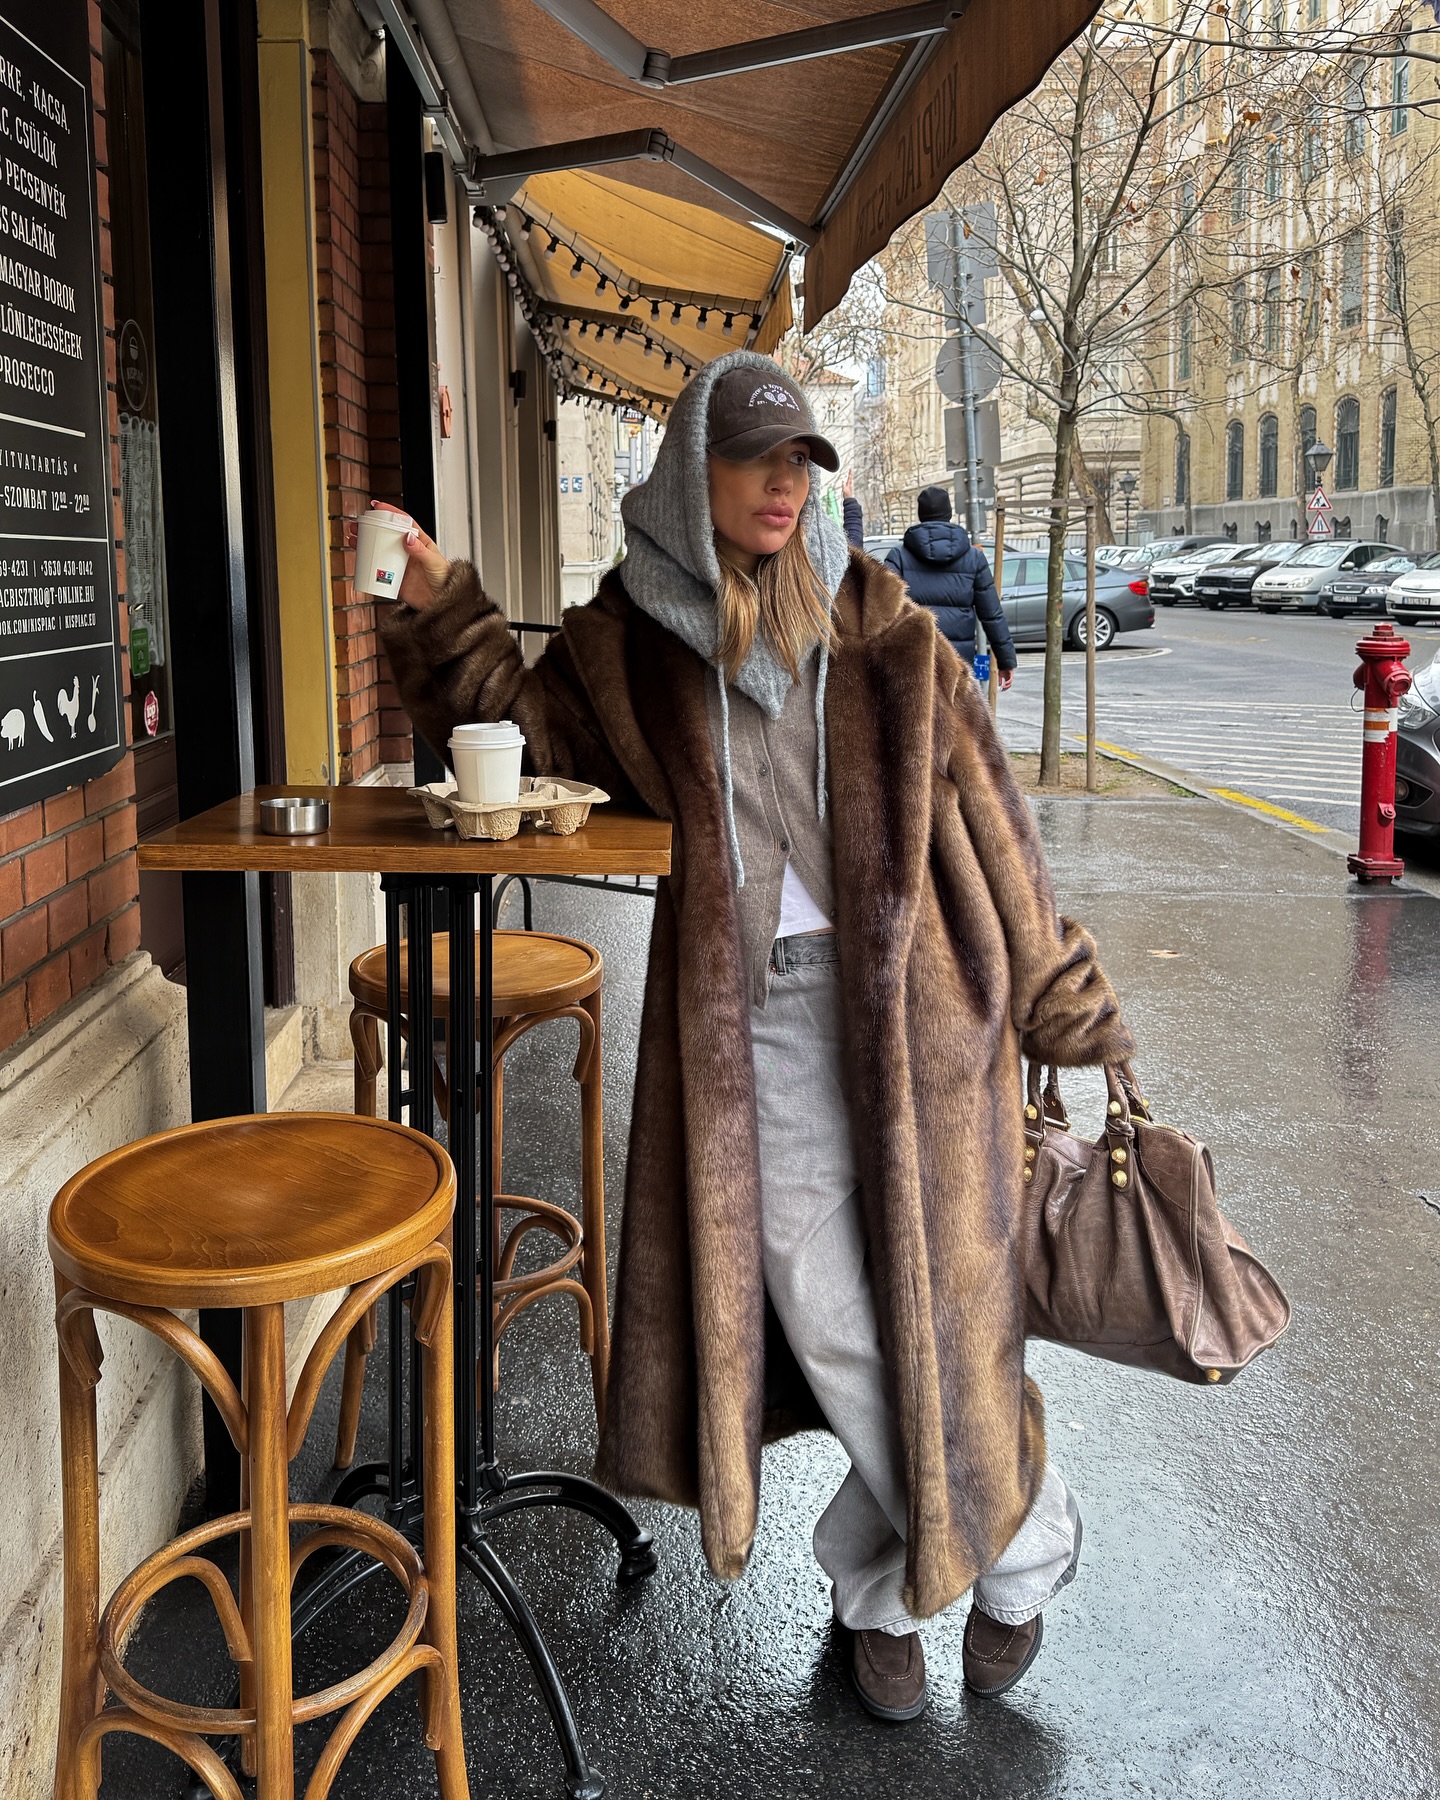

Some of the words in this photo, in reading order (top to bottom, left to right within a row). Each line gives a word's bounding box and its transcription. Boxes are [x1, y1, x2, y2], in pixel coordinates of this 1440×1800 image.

[28, 80, 71, 135] -KACSA,
[0, 106, 13, 141] C,
[15, 116, 58, 169] CSÜLÖK
[5, 157, 67, 220] PECSENYÉK
[0, 205, 9, 235] S
[11, 210, 57, 260] SALÁTÁK
[0, 253, 42, 299] MAGYAR
[43, 274, 76, 314] BOROK
[63, 560, 94, 576] 430-0142
[0, 616, 56, 636] OK.COM/KISPIAC
[65, 613, 96, 629] KISPIAC.EU
